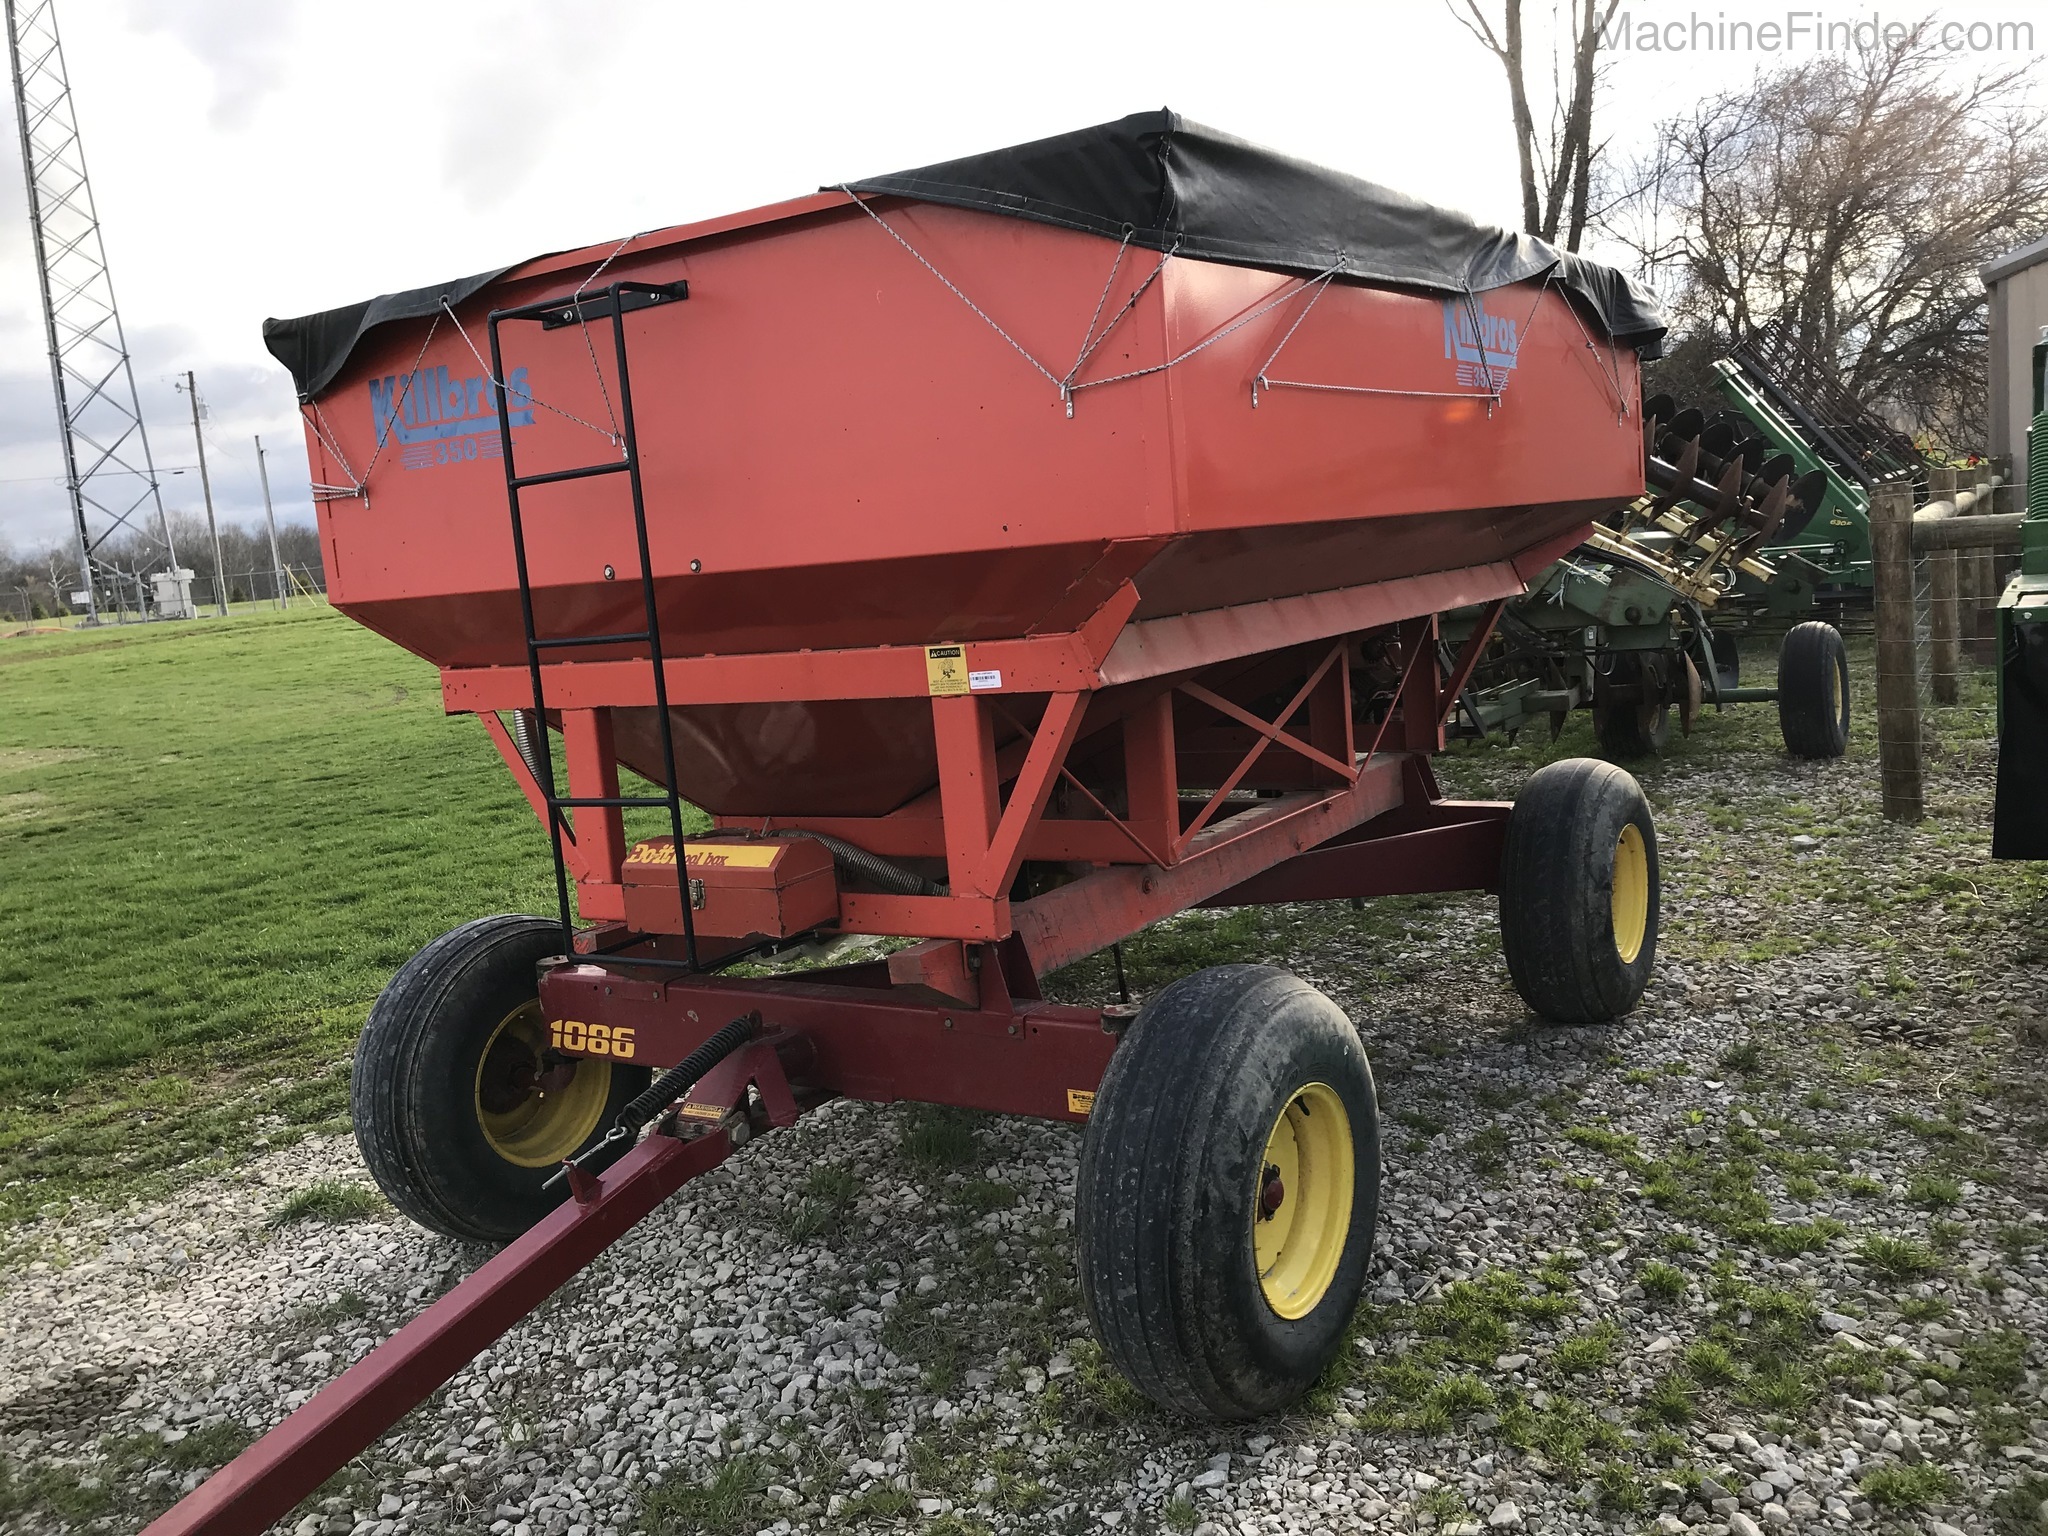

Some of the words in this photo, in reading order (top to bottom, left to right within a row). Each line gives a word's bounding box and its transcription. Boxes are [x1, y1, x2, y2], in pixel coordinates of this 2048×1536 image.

[1443, 297, 1518, 359] Killbros
[368, 364, 533, 448] Killbros
[435, 438, 477, 465] 350
[936, 649, 960, 657] CAUTION
[680, 852, 704, 866] ool
[704, 852, 729, 866] box
[550, 1019, 635, 1058] 1086
